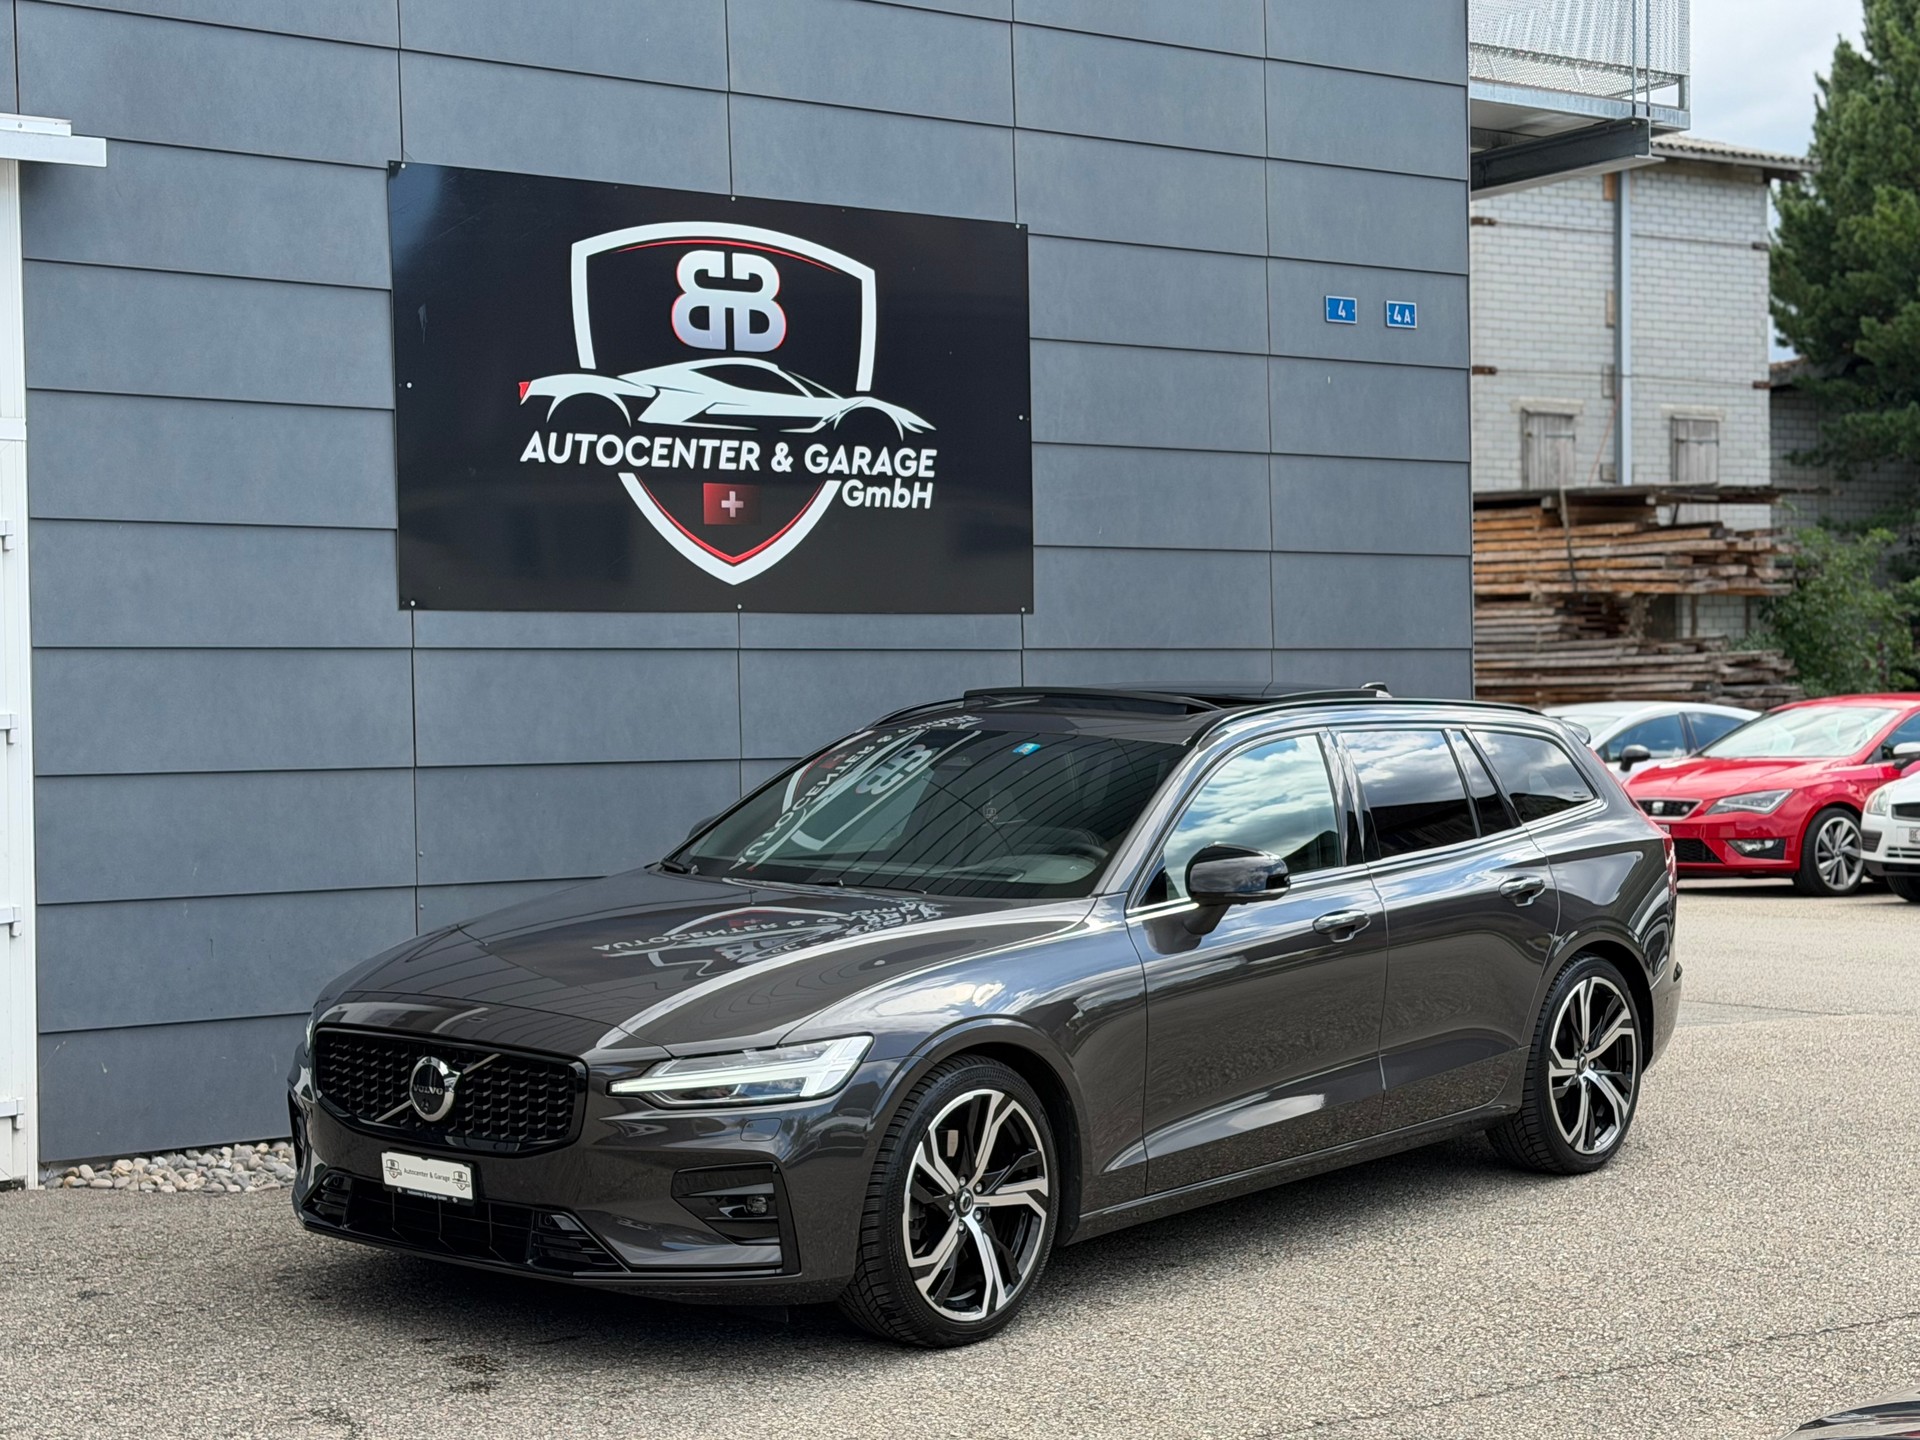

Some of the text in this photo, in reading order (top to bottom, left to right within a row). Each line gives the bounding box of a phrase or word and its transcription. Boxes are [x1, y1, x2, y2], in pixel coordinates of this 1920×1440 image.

[1338, 300, 1346, 318] 4
[1393, 305, 1411, 323] 4A
[519, 430, 938, 478] AUTOCENTER & GARAGE
[841, 478, 934, 509] GmbH
[413, 1084, 444, 1096] VOLVO
[403, 1168, 428, 1178] Autocenter
[434, 1172, 450, 1182] Garage
